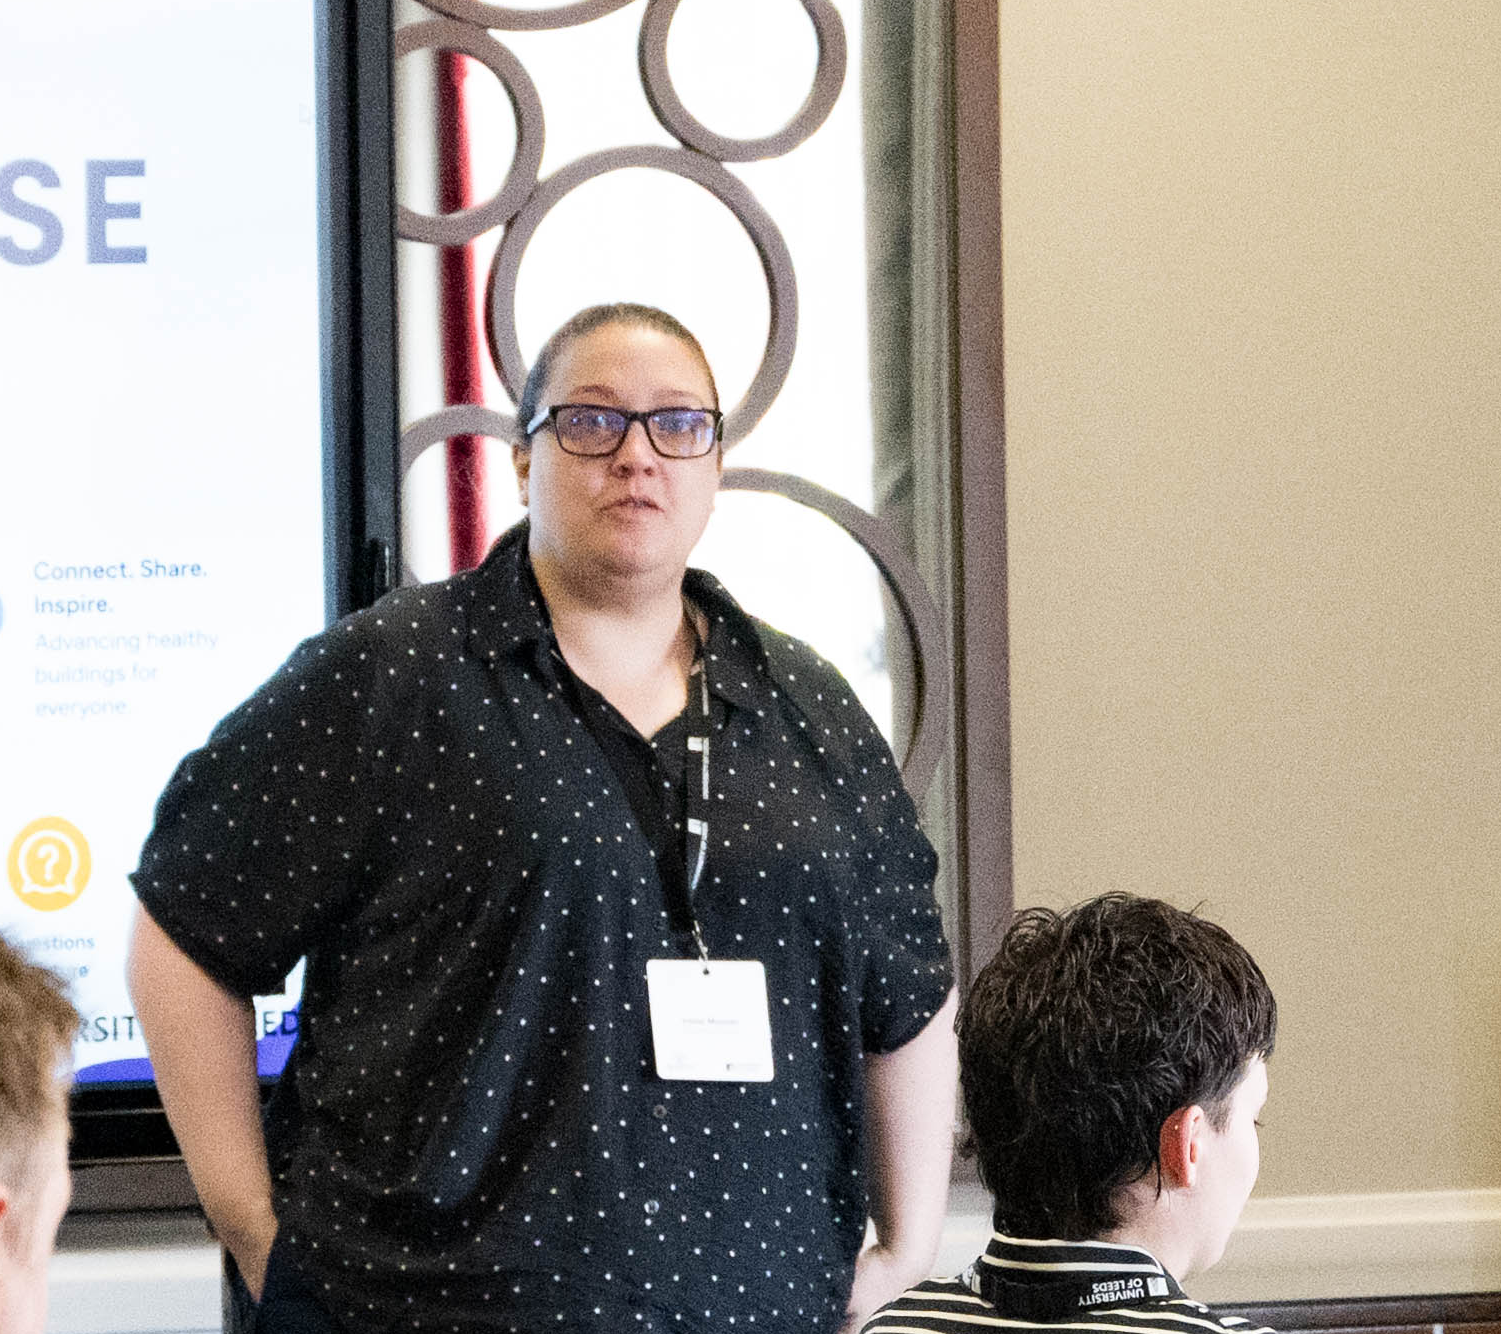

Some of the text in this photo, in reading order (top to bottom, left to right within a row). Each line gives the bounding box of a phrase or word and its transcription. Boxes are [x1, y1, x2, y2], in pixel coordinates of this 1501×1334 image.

[33, 558, 209, 581] Connect. Share.
[34, 595, 113, 617] Inspire.
[34, 628, 219, 655] Advancing healthy
[34, 662, 159, 688] buildings for
[1092, 1277, 1144, 1293] OF LEEDS
[1078, 1288, 1146, 1307] UNIVERSITY
